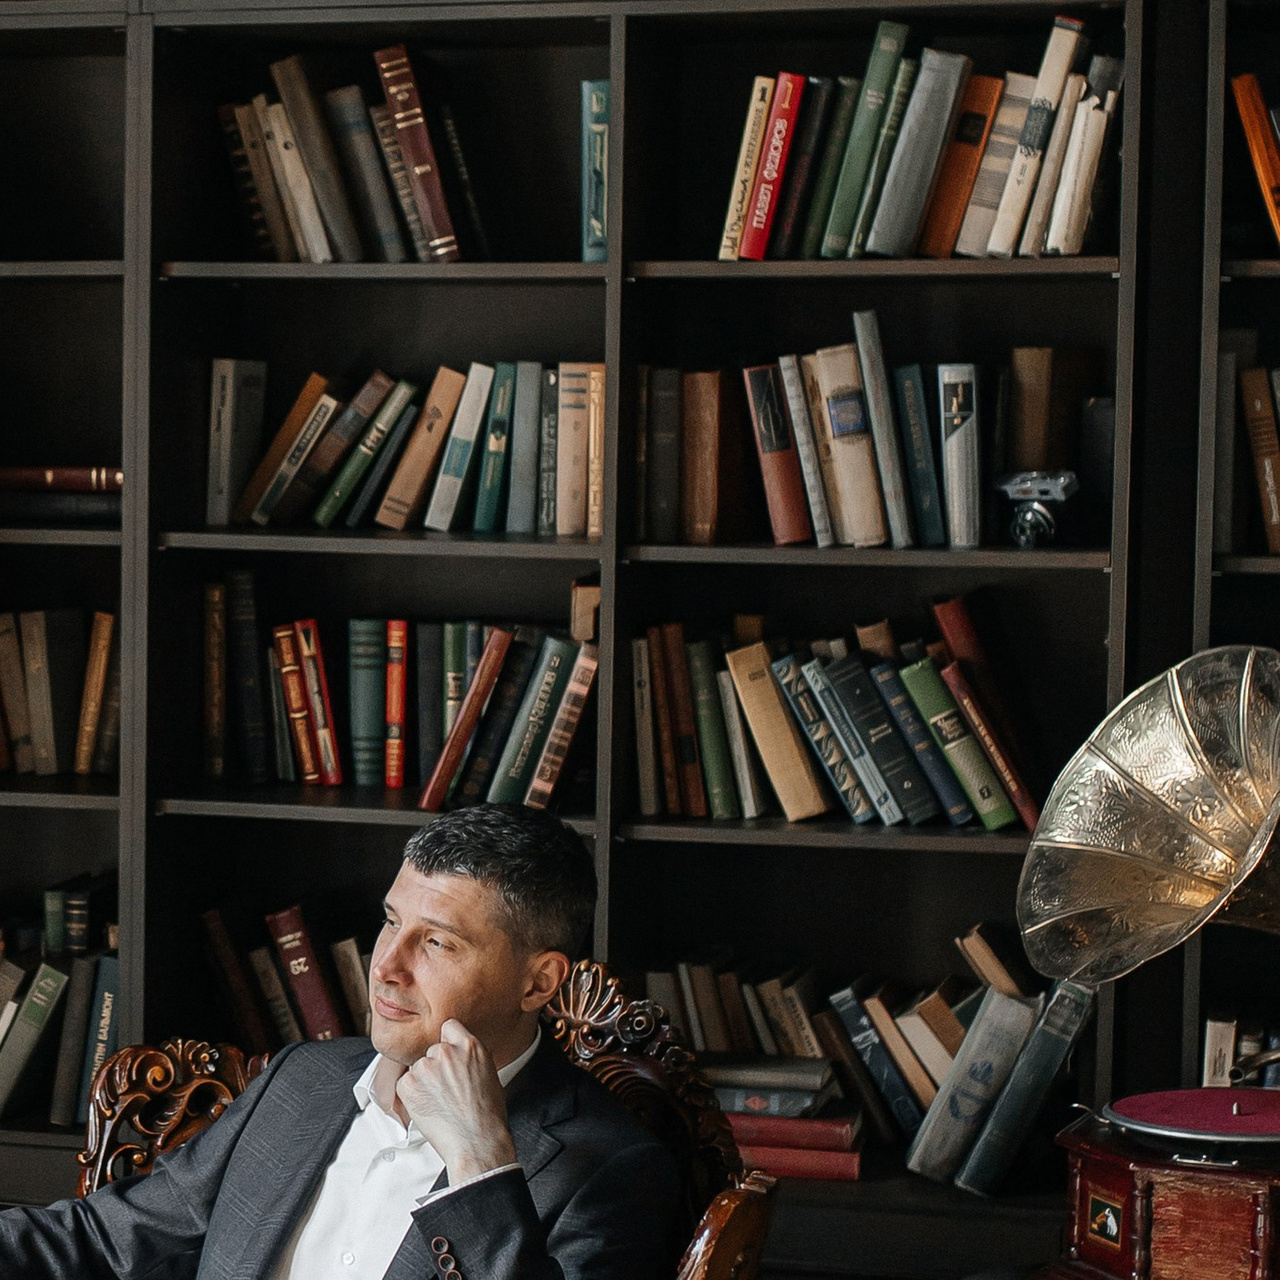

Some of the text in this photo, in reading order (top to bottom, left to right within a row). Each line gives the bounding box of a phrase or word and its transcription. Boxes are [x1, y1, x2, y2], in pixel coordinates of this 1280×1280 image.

[747, 183, 773, 229] ПАВЕЛ
[763, 118, 787, 181] ФЕДОРОВ
[289, 956, 310, 976] 29
